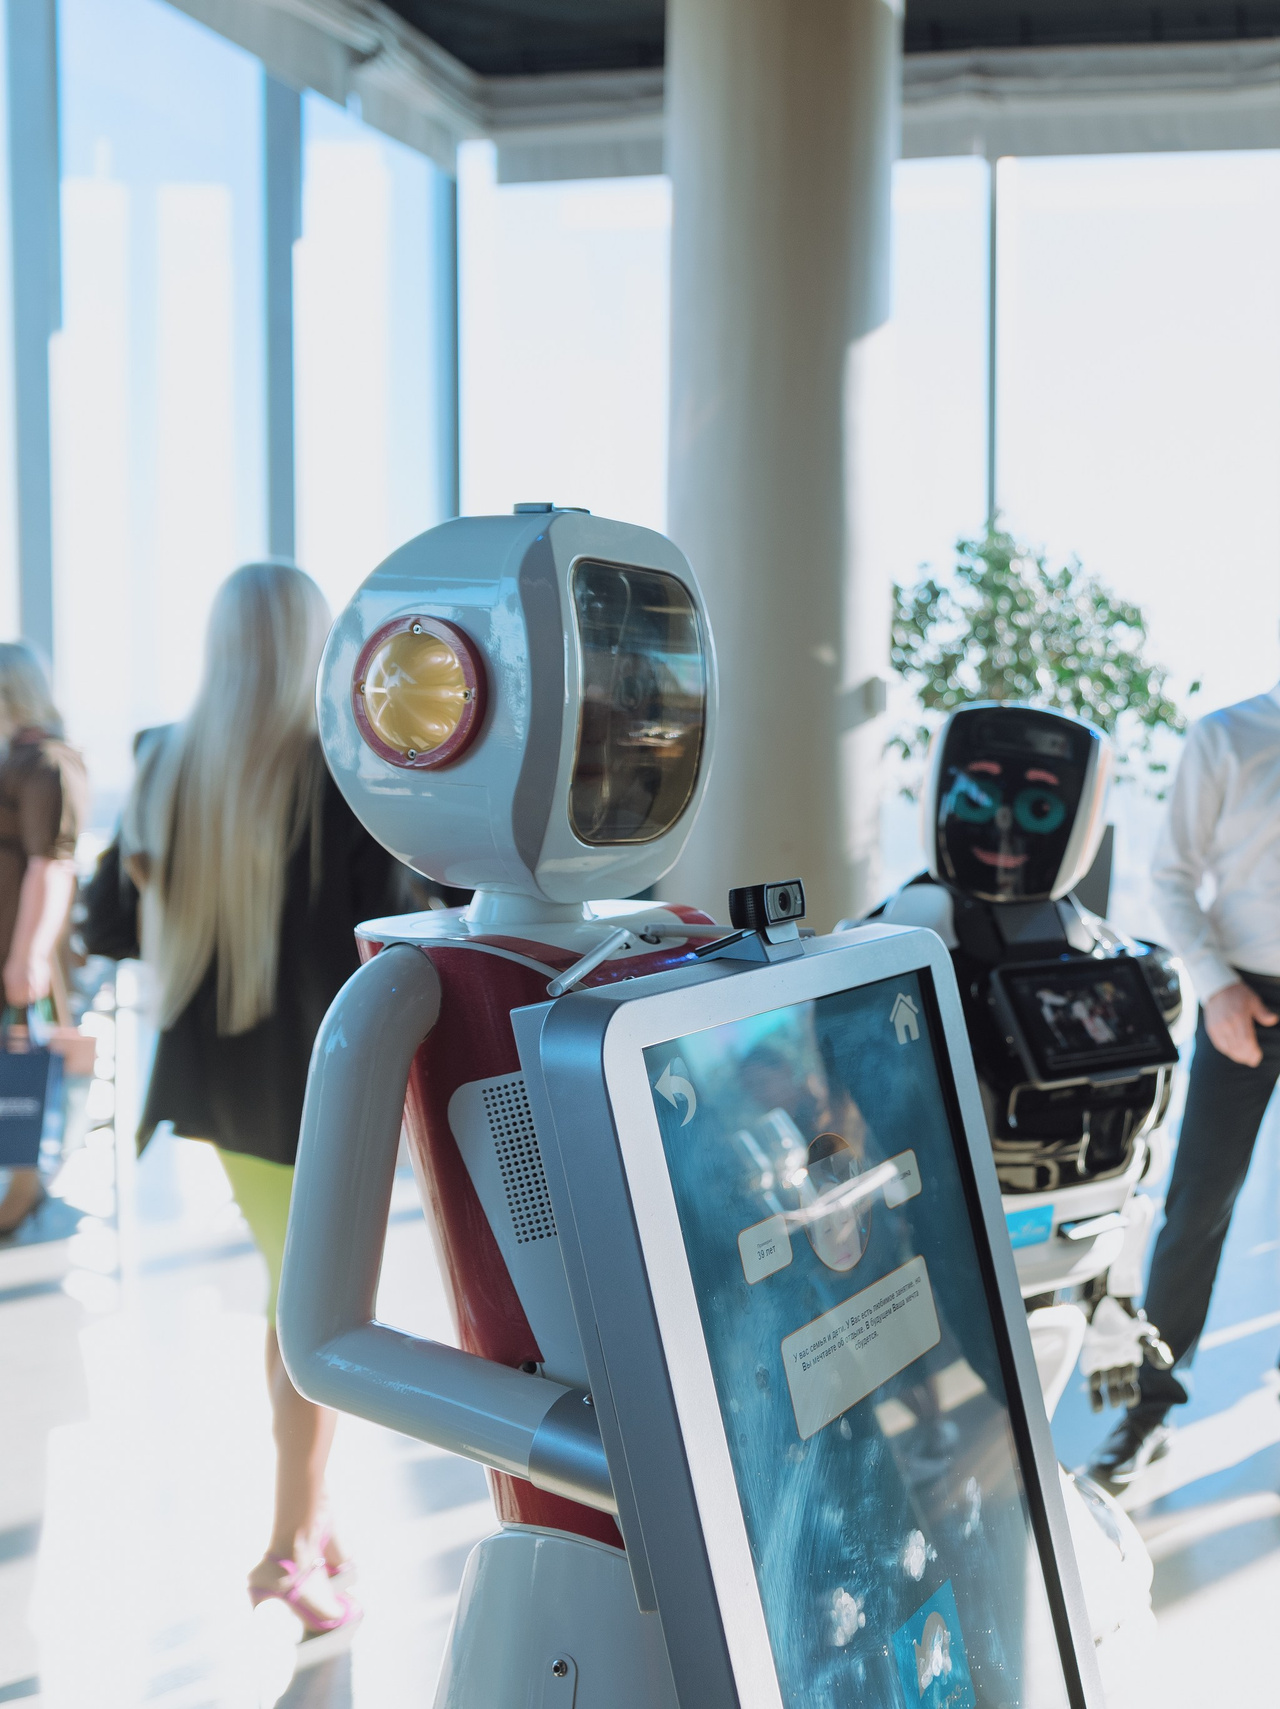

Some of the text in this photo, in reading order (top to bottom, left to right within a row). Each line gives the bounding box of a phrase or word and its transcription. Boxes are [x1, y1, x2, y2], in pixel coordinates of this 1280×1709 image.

[757, 1245, 776, 1260] 39 лет
[793, 1352, 798, 1363] У
[799, 1348, 809, 1360] вас
[810, 1336, 827, 1352] семья
[827, 1333, 832, 1341] и
[845, 1319, 850, 1329] У
[850, 1315, 861, 1326] Вас
[861, 1308, 873, 1319] есть
[872, 1298, 895, 1312] любимое
[802, 1361, 812, 1372] Вы
[812, 1344, 837, 1365] мечтаете
[837, 1337, 845, 1349] об
[865, 1320, 870, 1330] В
[869, 1307, 892, 1327] будущем
[892, 1299, 905, 1312] Ваша
[905, 1290, 919, 1303] мечта
